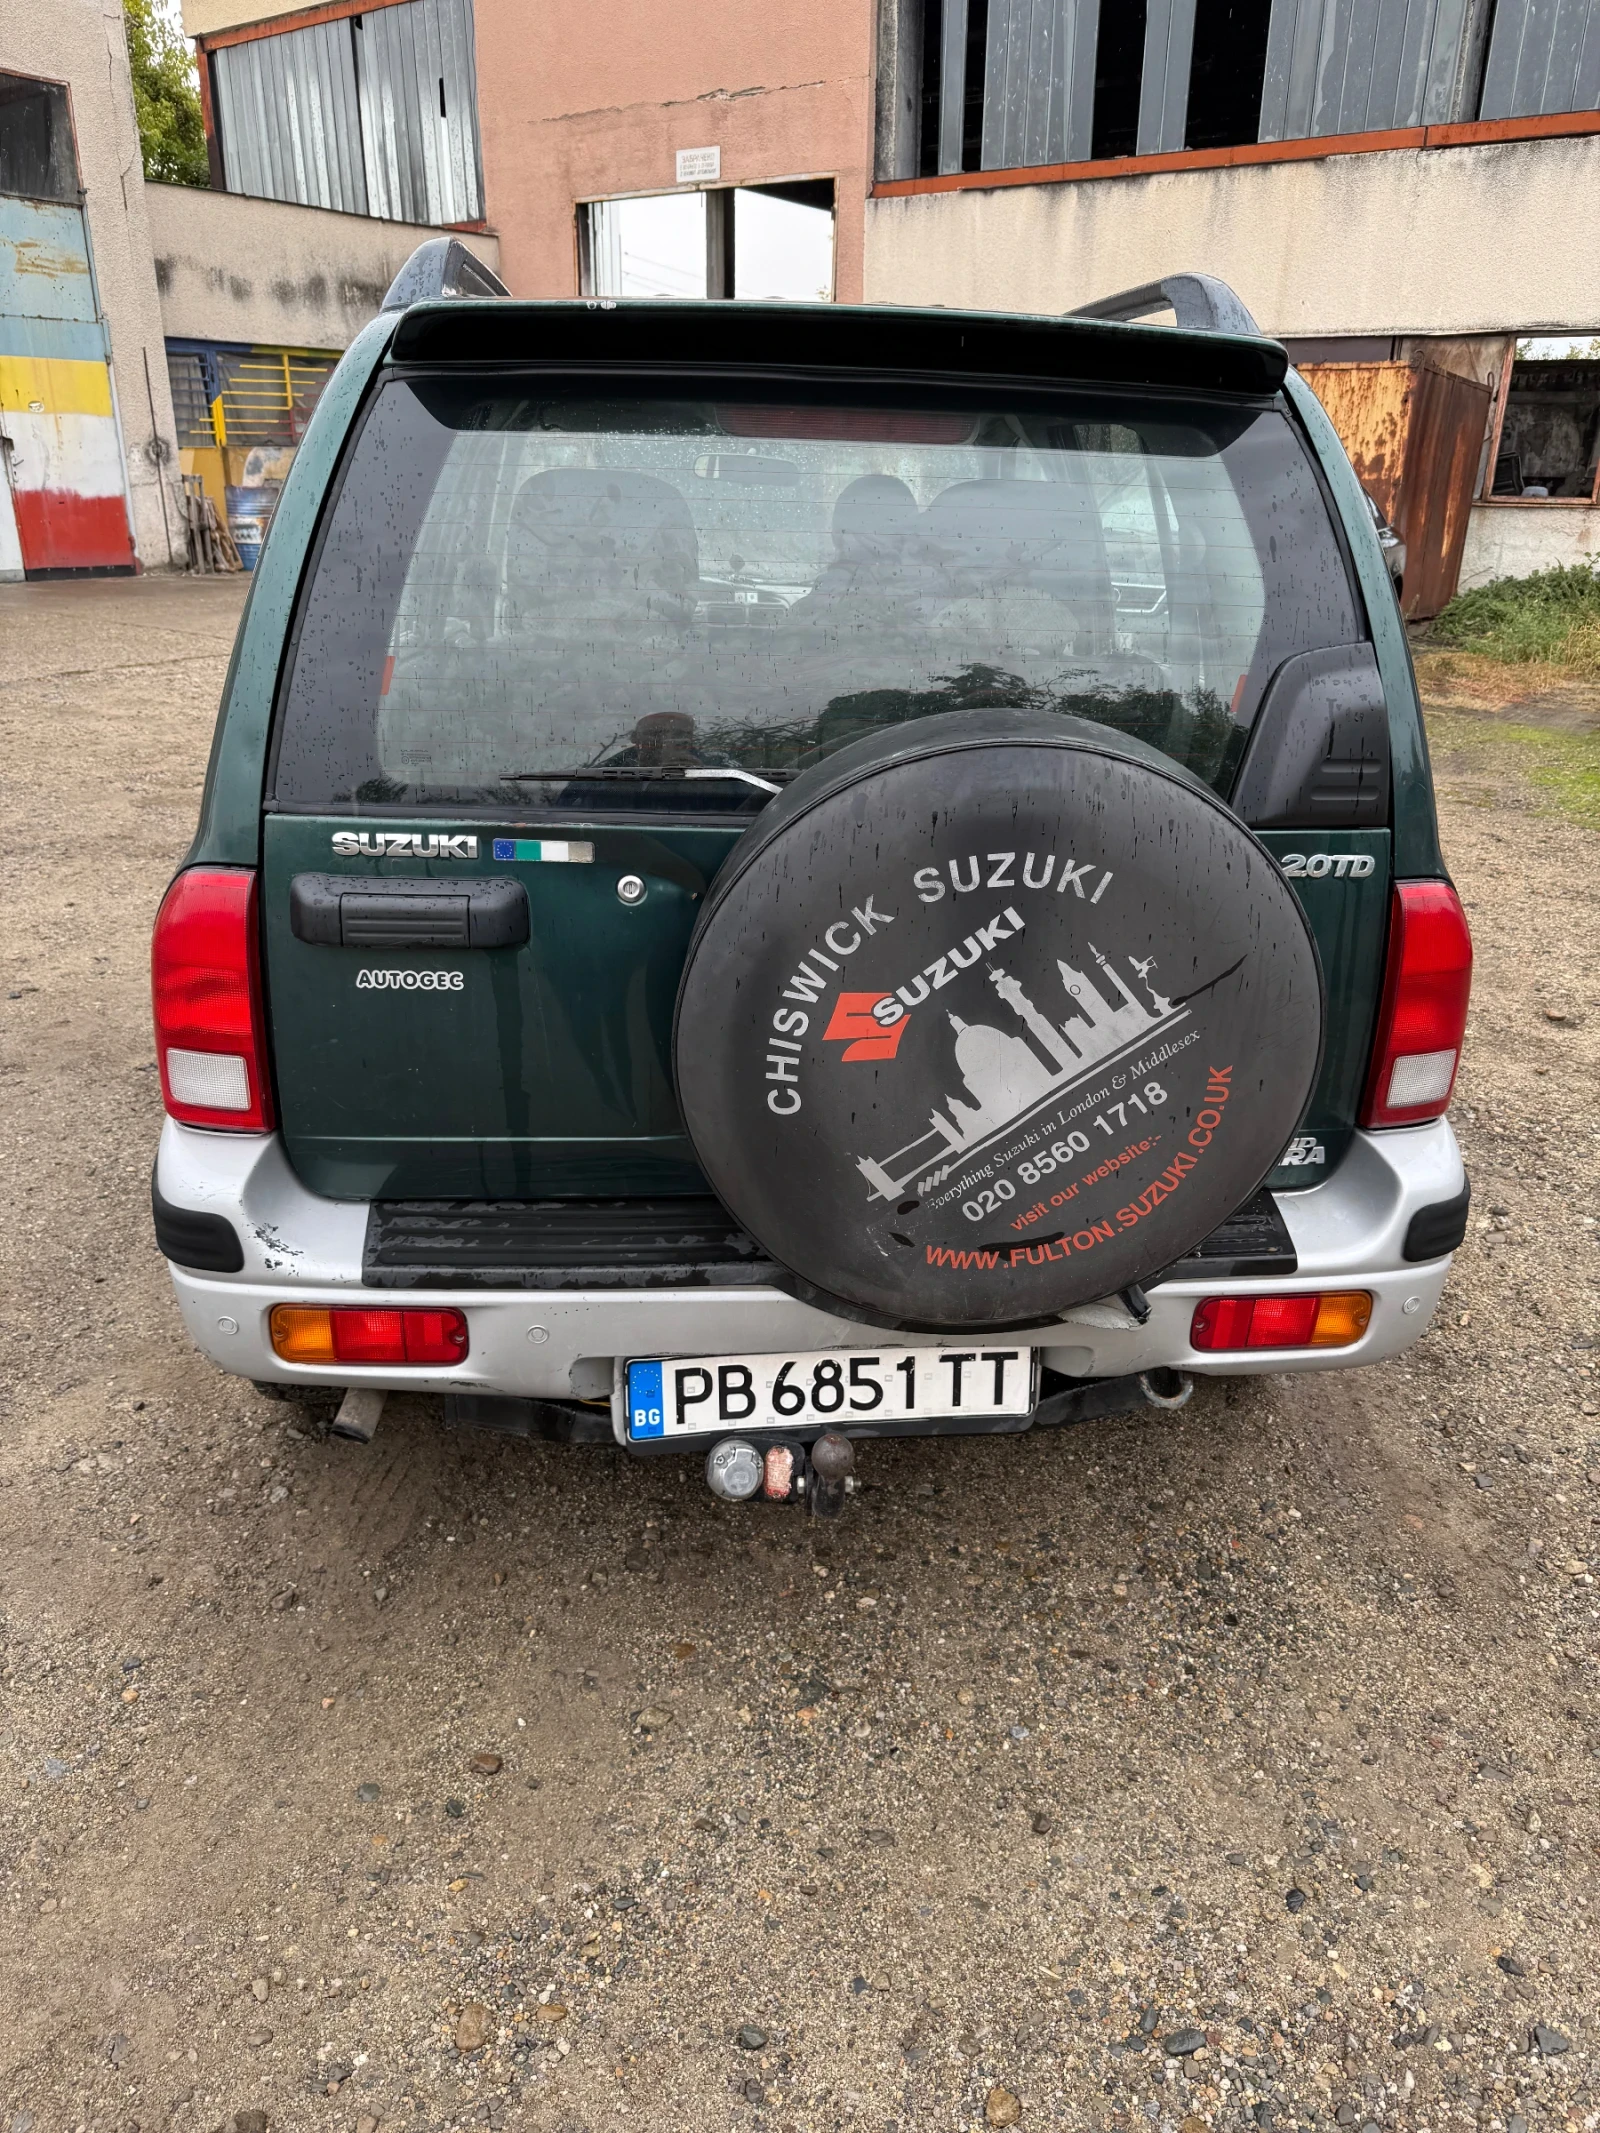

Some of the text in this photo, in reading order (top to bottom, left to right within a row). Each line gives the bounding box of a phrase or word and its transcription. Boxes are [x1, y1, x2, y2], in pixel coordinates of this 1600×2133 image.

[331, 831, 479, 859] SUZUKI
[356, 970, 464, 990] AUTOGEC
[765, 851, 1114, 1116] CHISWICK SUZUKI
[872, 906, 1026, 1025] SUZUKI
[993, 1129, 1040, 1168] Suzuki
[1040, 1120, 1057, 1136] in
[1057, 1087, 1111, 1126] London
[1111, 1073, 1127, 1090] &
[1129, 1030, 1201, 1081] Middlesex
[961, 1081, 1168, 1222] 020 8560 1718
[1010, 1201, 1050, 1231] visit
[1050, 1182, 1080, 1207] our
[633, 1409, 661, 1427] BG
[674, 1351, 1019, 1425] PB 6851 TT
